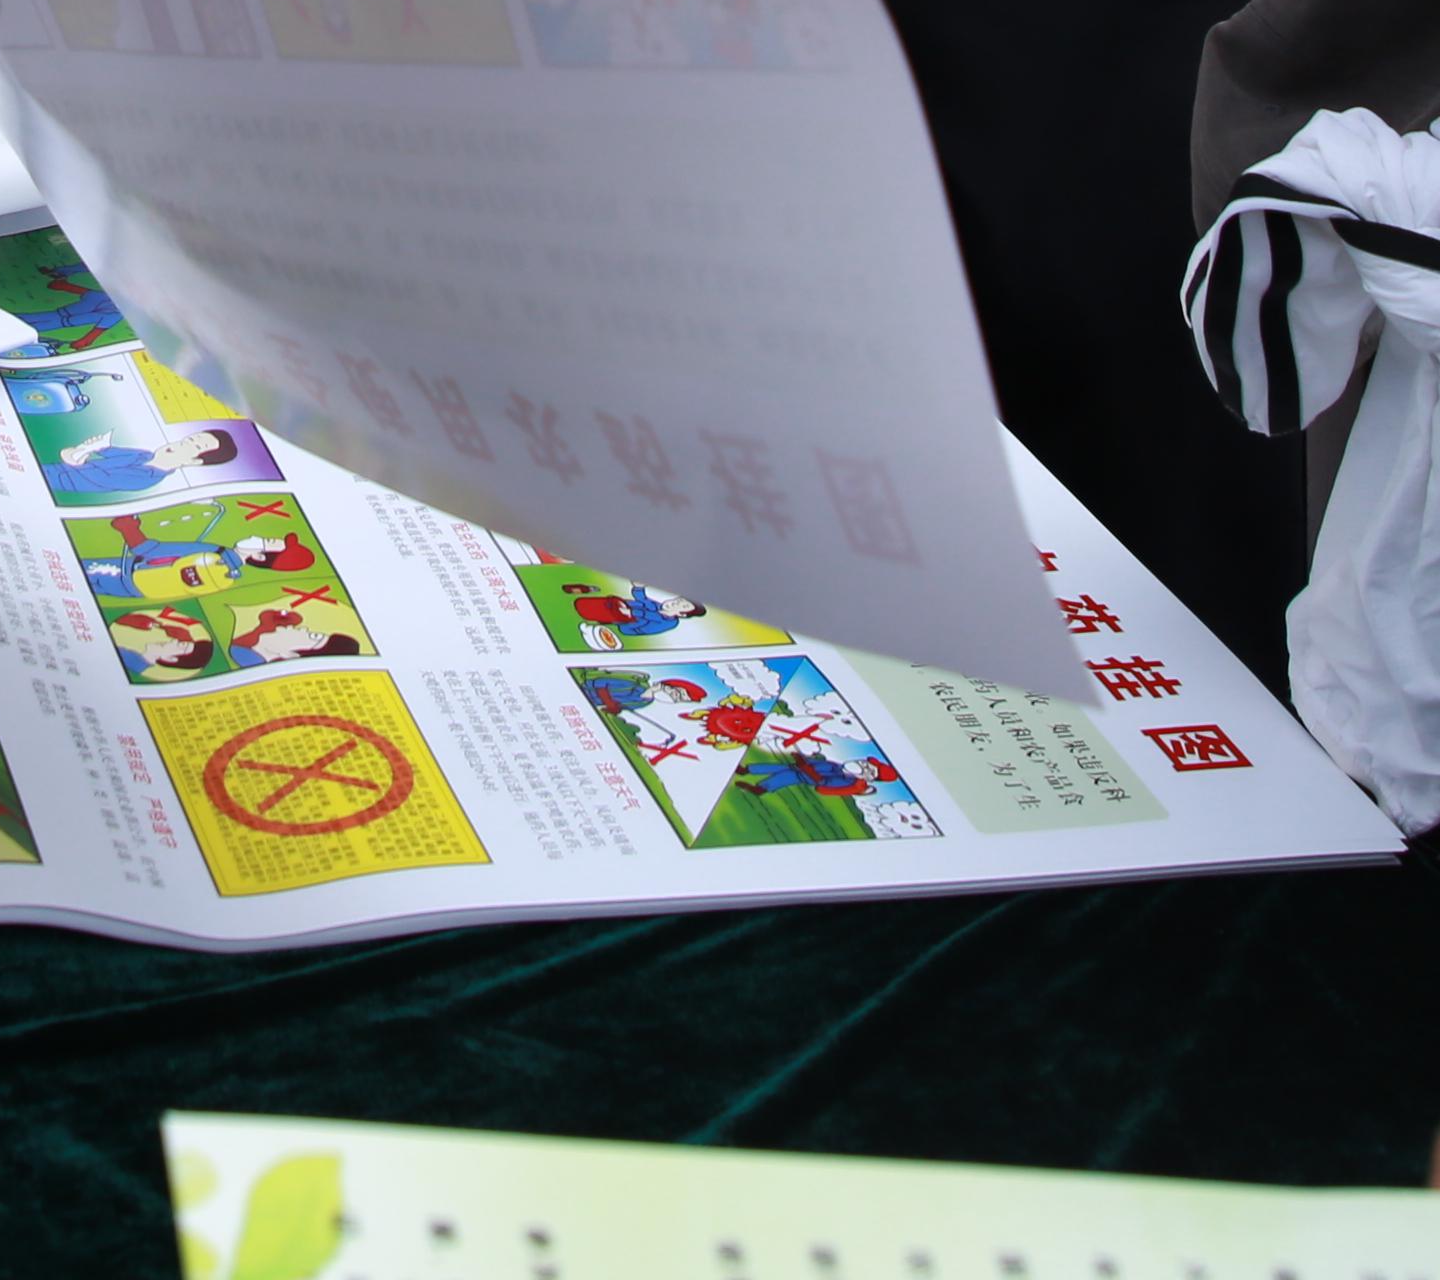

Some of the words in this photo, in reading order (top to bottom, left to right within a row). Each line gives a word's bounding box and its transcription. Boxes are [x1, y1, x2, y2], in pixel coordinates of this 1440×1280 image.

[480, 565, 522, 614] 远离水源
[594, 761, 642, 811] 注意天气
